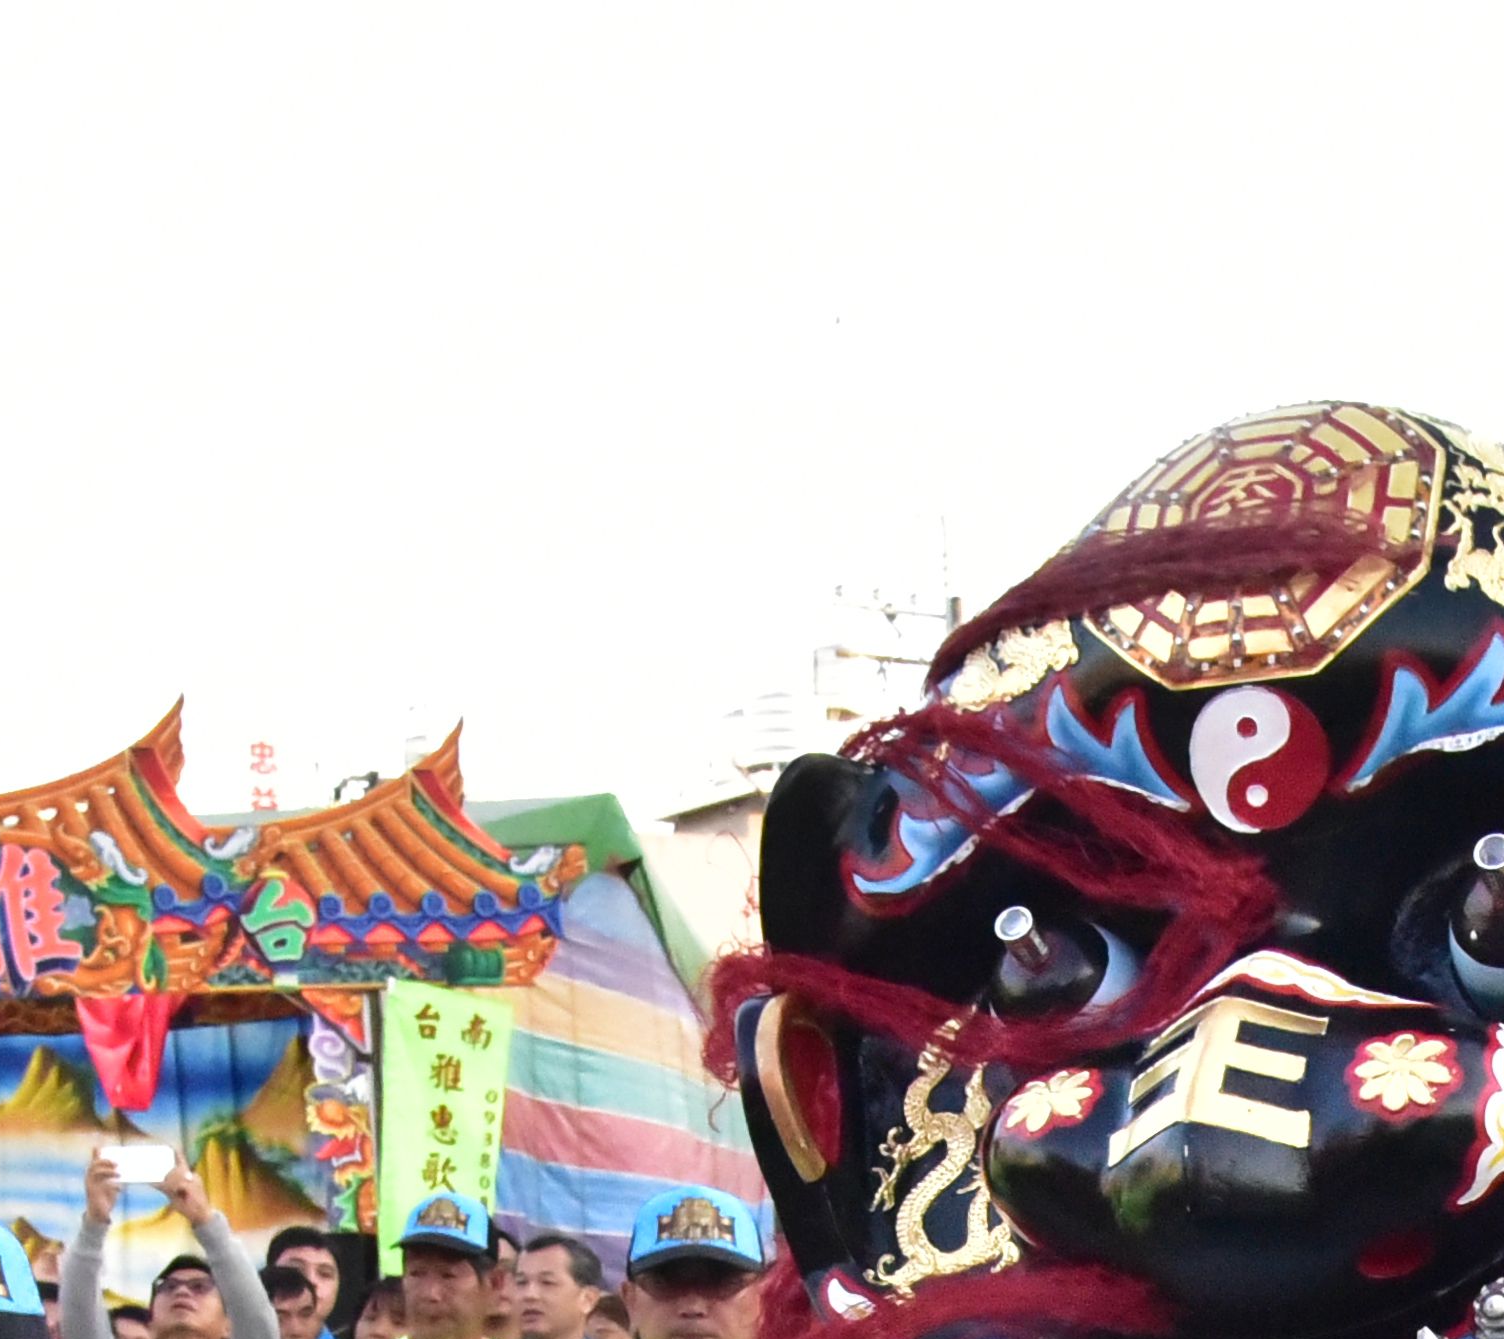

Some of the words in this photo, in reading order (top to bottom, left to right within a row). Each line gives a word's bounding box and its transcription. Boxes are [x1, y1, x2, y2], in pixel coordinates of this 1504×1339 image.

[240, 880, 316, 962] 台
[422, 1053, 464, 1192] 雅惠歌
